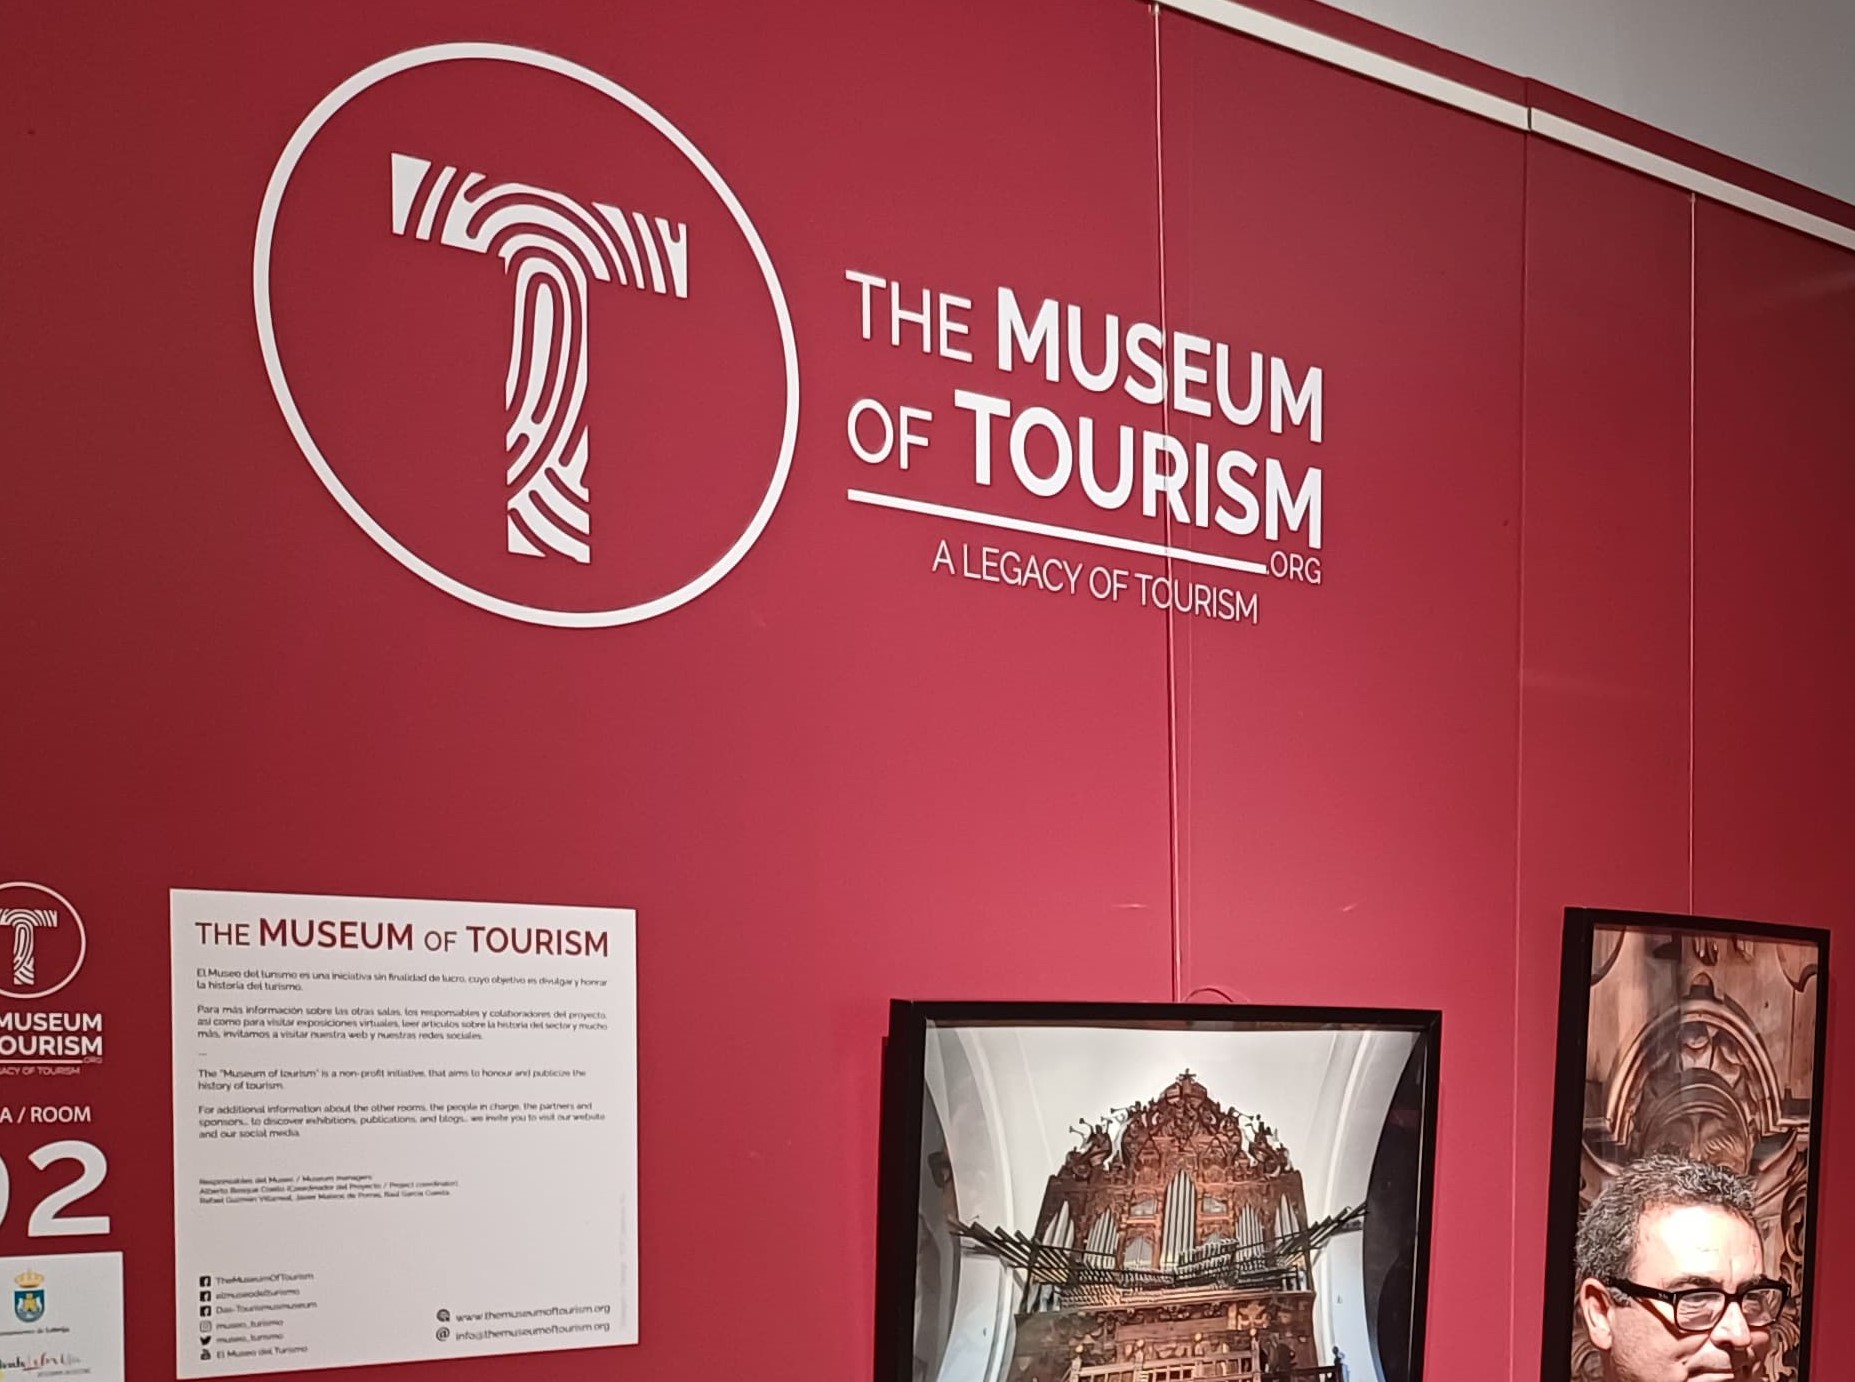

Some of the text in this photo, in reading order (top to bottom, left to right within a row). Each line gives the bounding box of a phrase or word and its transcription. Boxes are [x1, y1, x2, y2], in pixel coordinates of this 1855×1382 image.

[845, 269, 1323, 443] THE MUSEUM
[847, 389, 1322, 549] OF TOURISM
[932, 539, 1258, 624] A LEGACY OF TOURISM
[194, 918, 607, 957] THE MUSEUM OF TOURISM
[31, 1106, 91, 1123] ROOM
